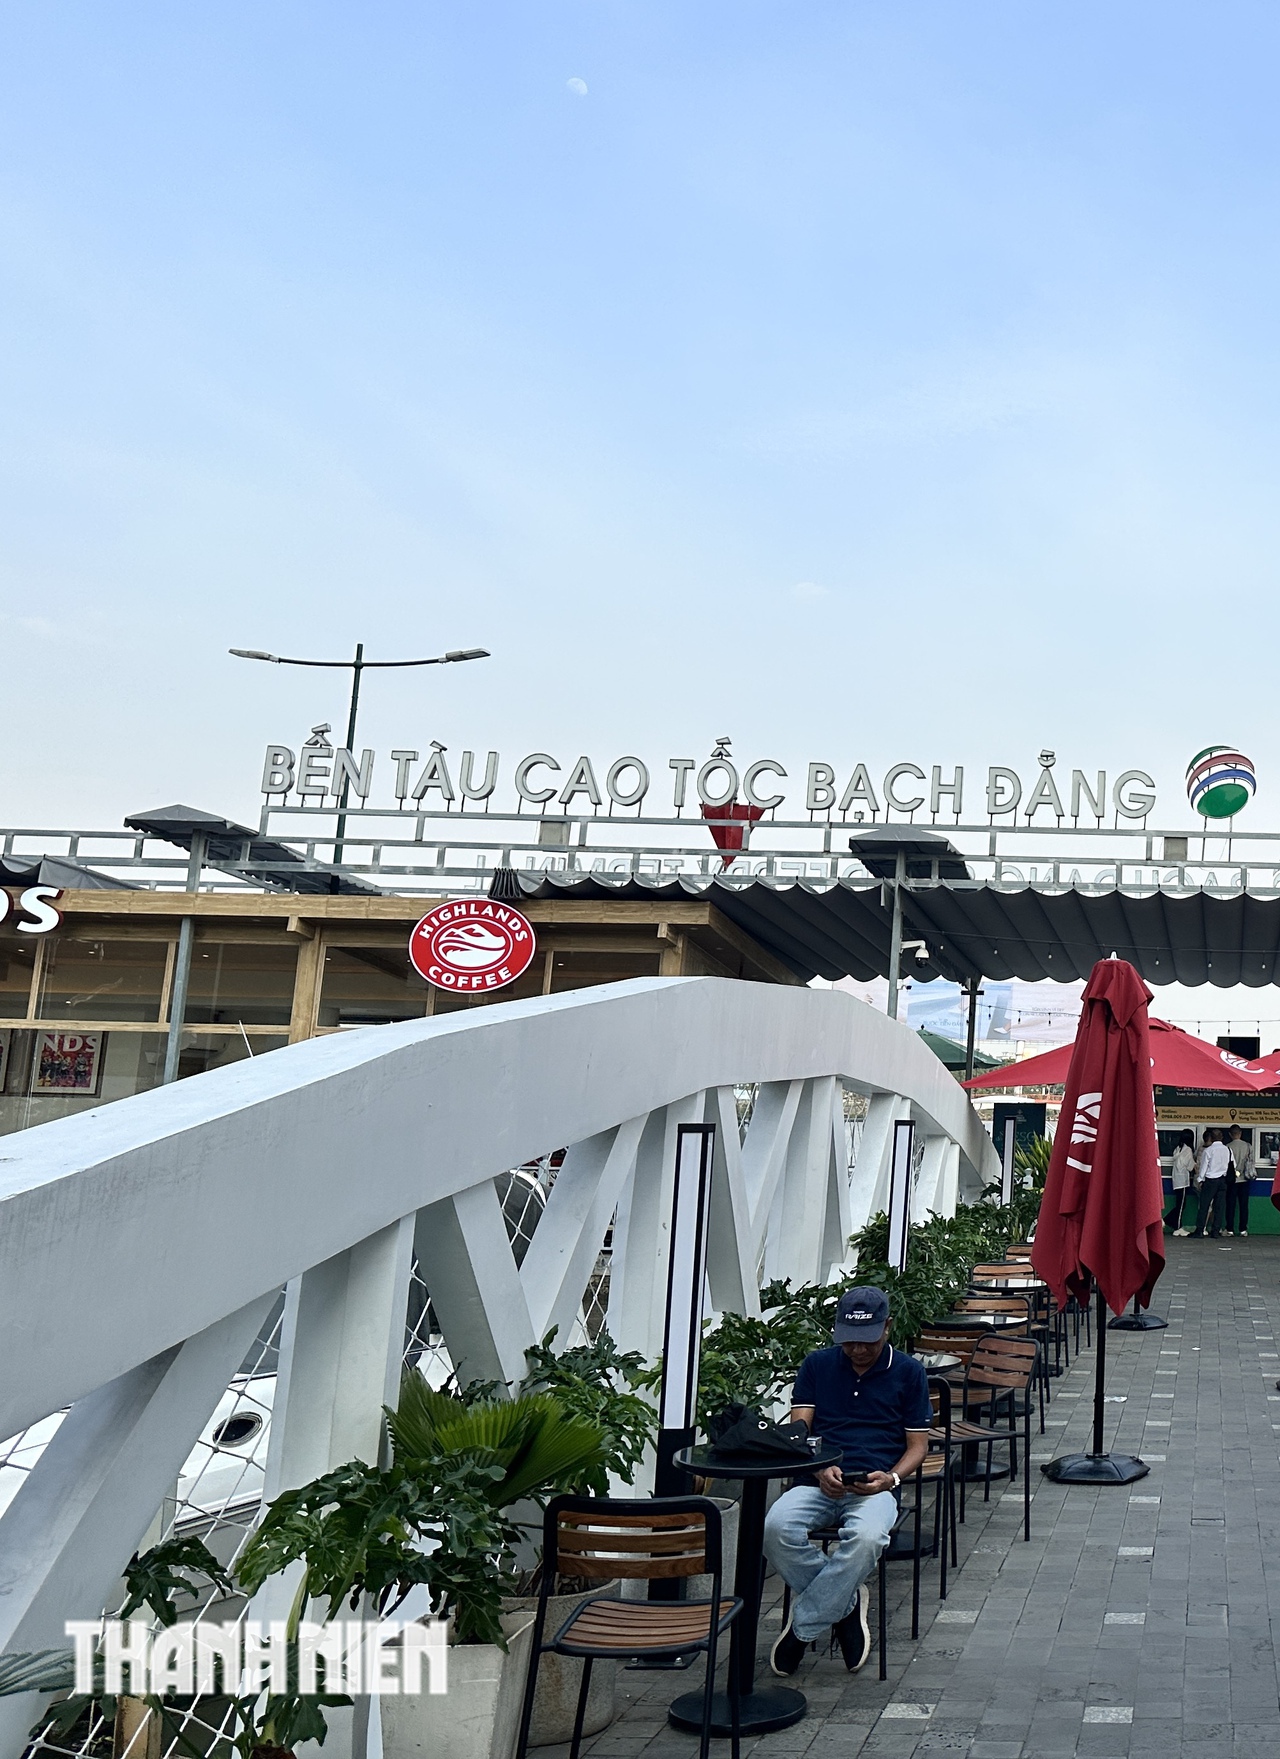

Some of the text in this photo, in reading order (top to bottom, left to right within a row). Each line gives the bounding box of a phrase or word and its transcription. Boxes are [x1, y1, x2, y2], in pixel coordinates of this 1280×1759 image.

[261, 723, 1156, 820] BẾN TÀU CAO TỐC BẠCH ĐẰNG
[419, 903, 528, 942] HIGHLANDS
[428, 965, 512, 988] COFFEE
